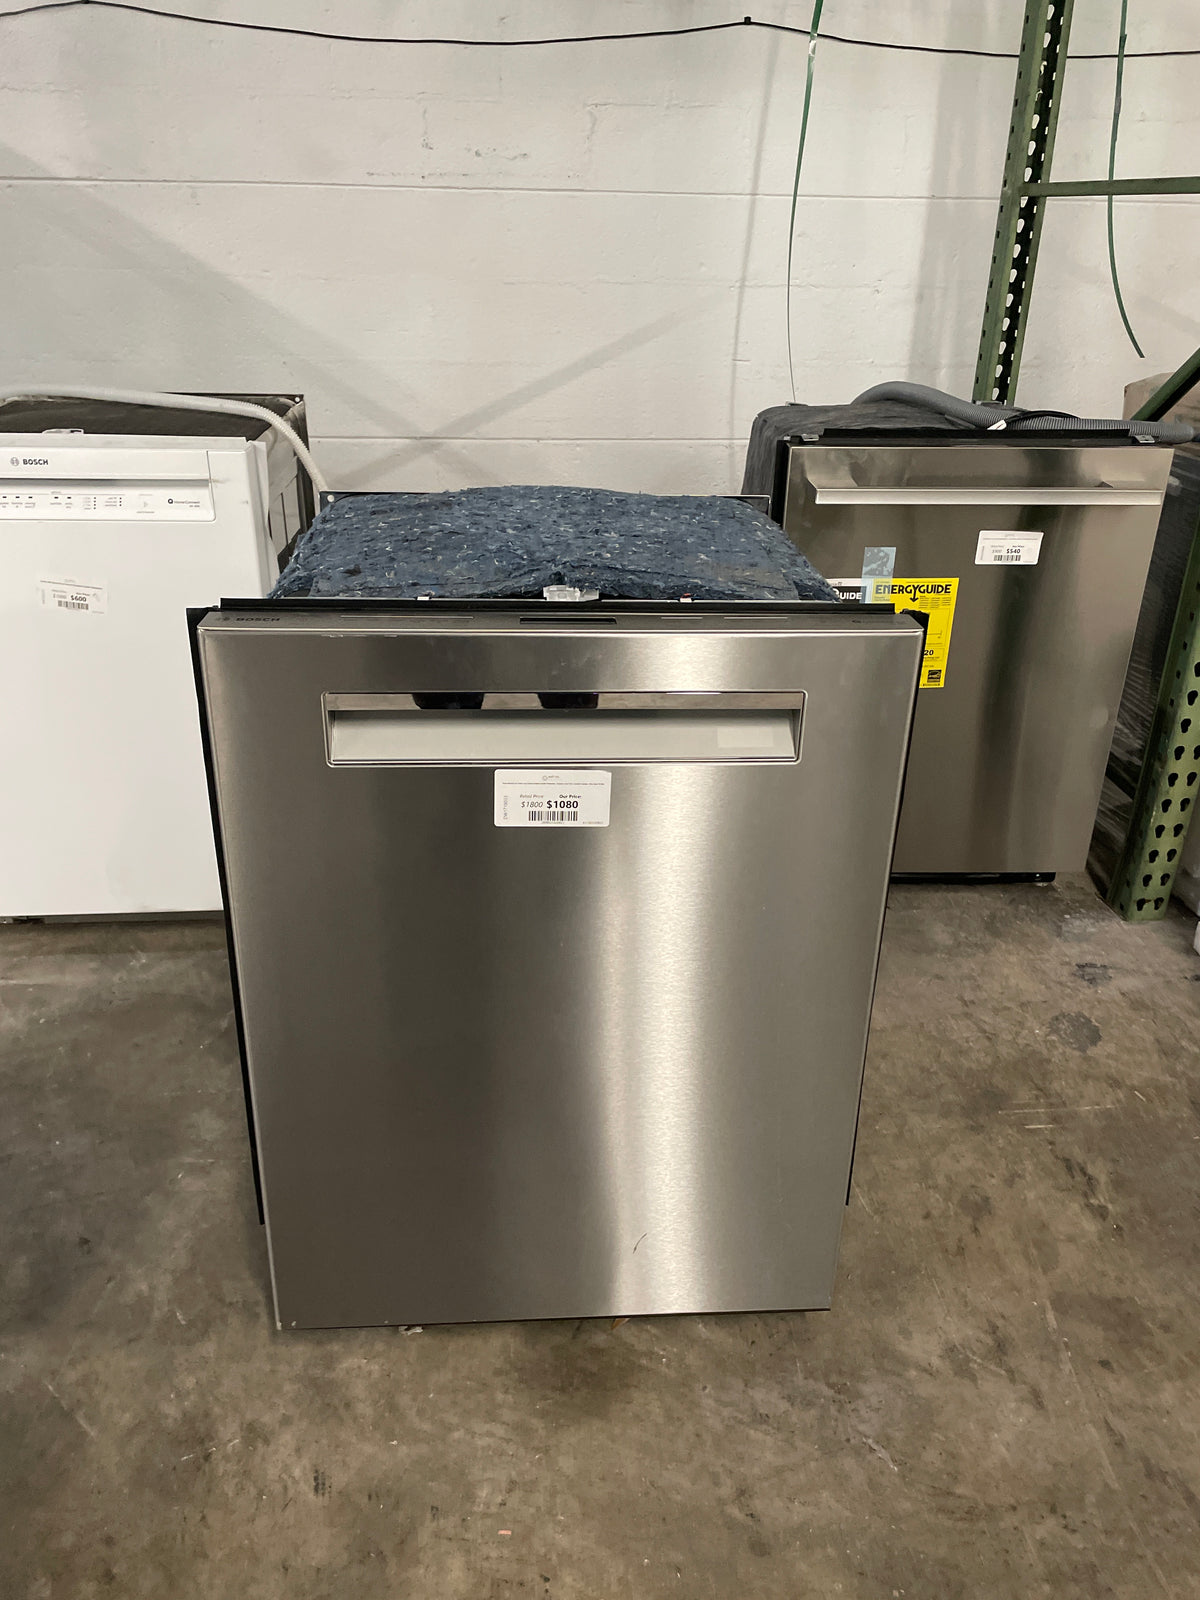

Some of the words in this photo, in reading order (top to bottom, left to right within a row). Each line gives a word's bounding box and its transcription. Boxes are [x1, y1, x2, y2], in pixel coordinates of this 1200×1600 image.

[22, 458, 49, 466] BOSCH
[874, 584, 952, 596] ENERGYGUIDE
[70, 594, 87, 603] $600
[520, 800, 544, 809] $1800
[546, 799, 579, 809] $1080
